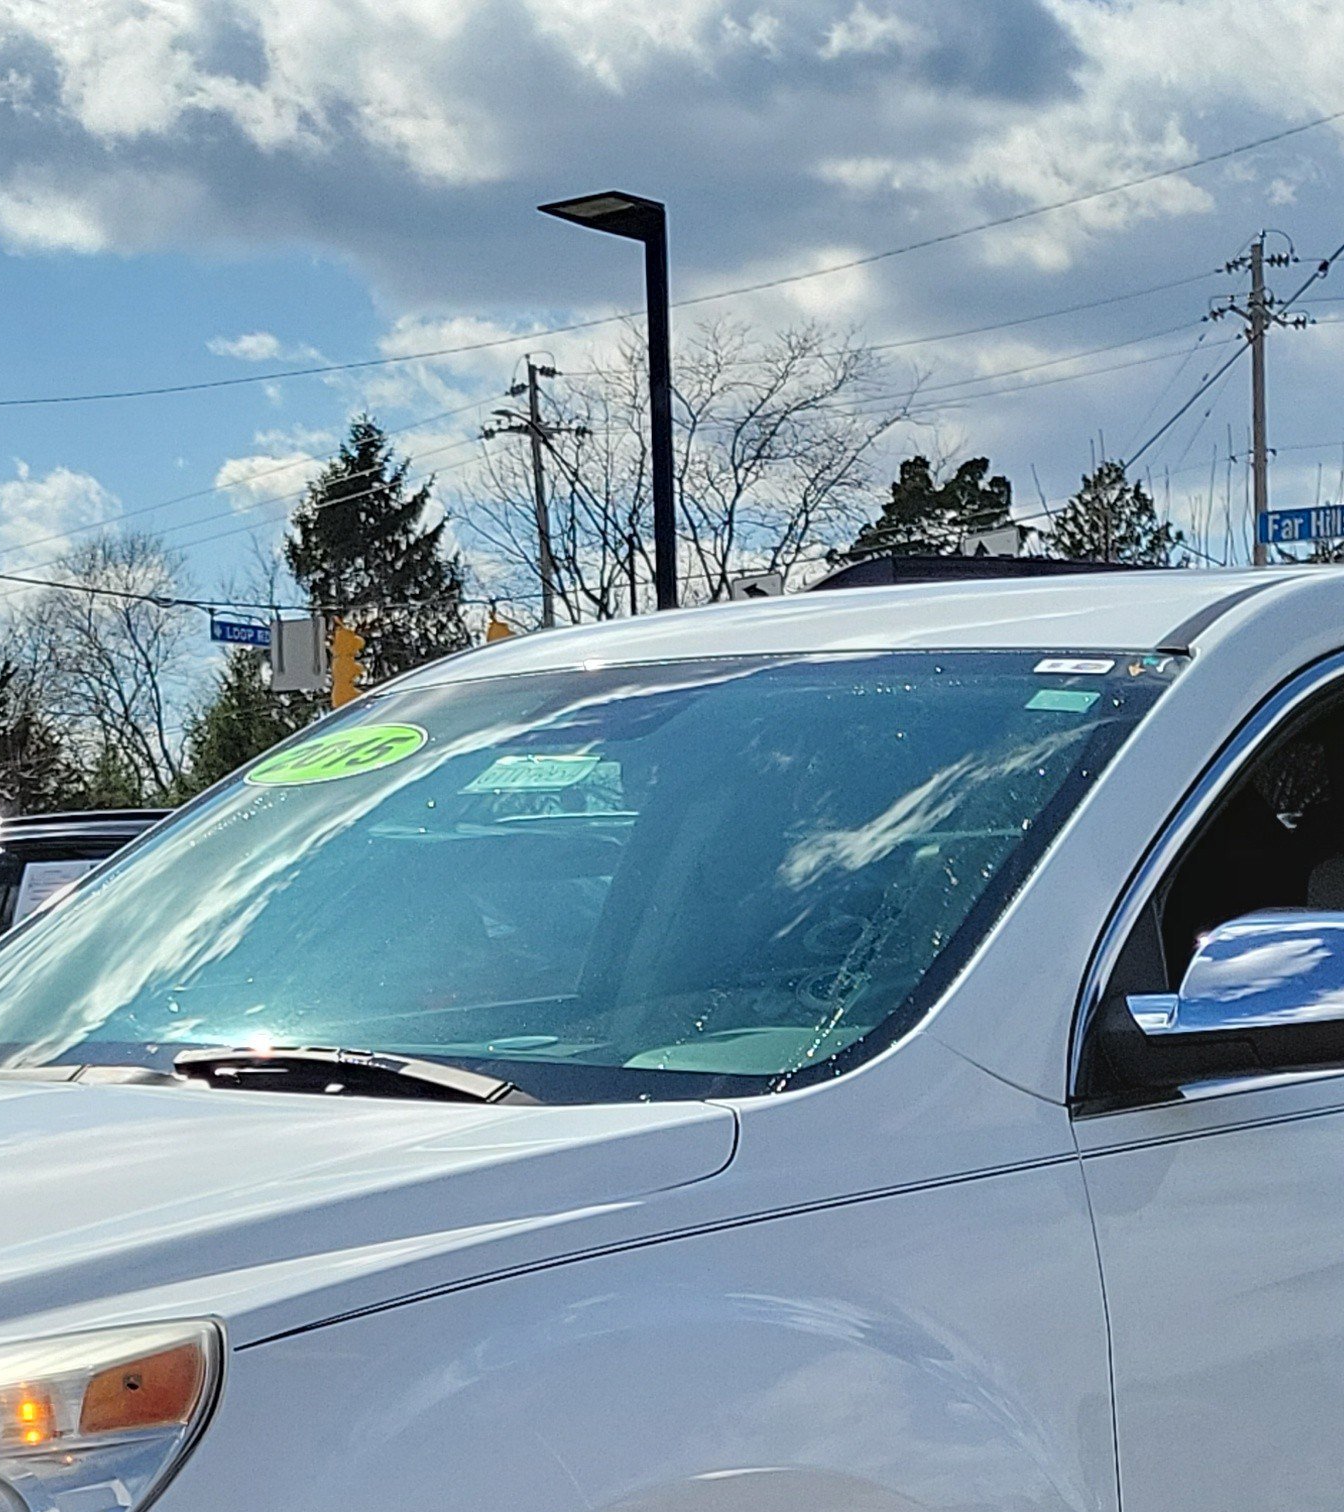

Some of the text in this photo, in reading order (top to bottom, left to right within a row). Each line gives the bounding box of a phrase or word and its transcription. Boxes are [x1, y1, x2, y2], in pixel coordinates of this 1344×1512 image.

[1267, 513, 1304, 541] Far
[225, 626, 255, 641] LOOP
[254, 735, 416, 778] 2015
